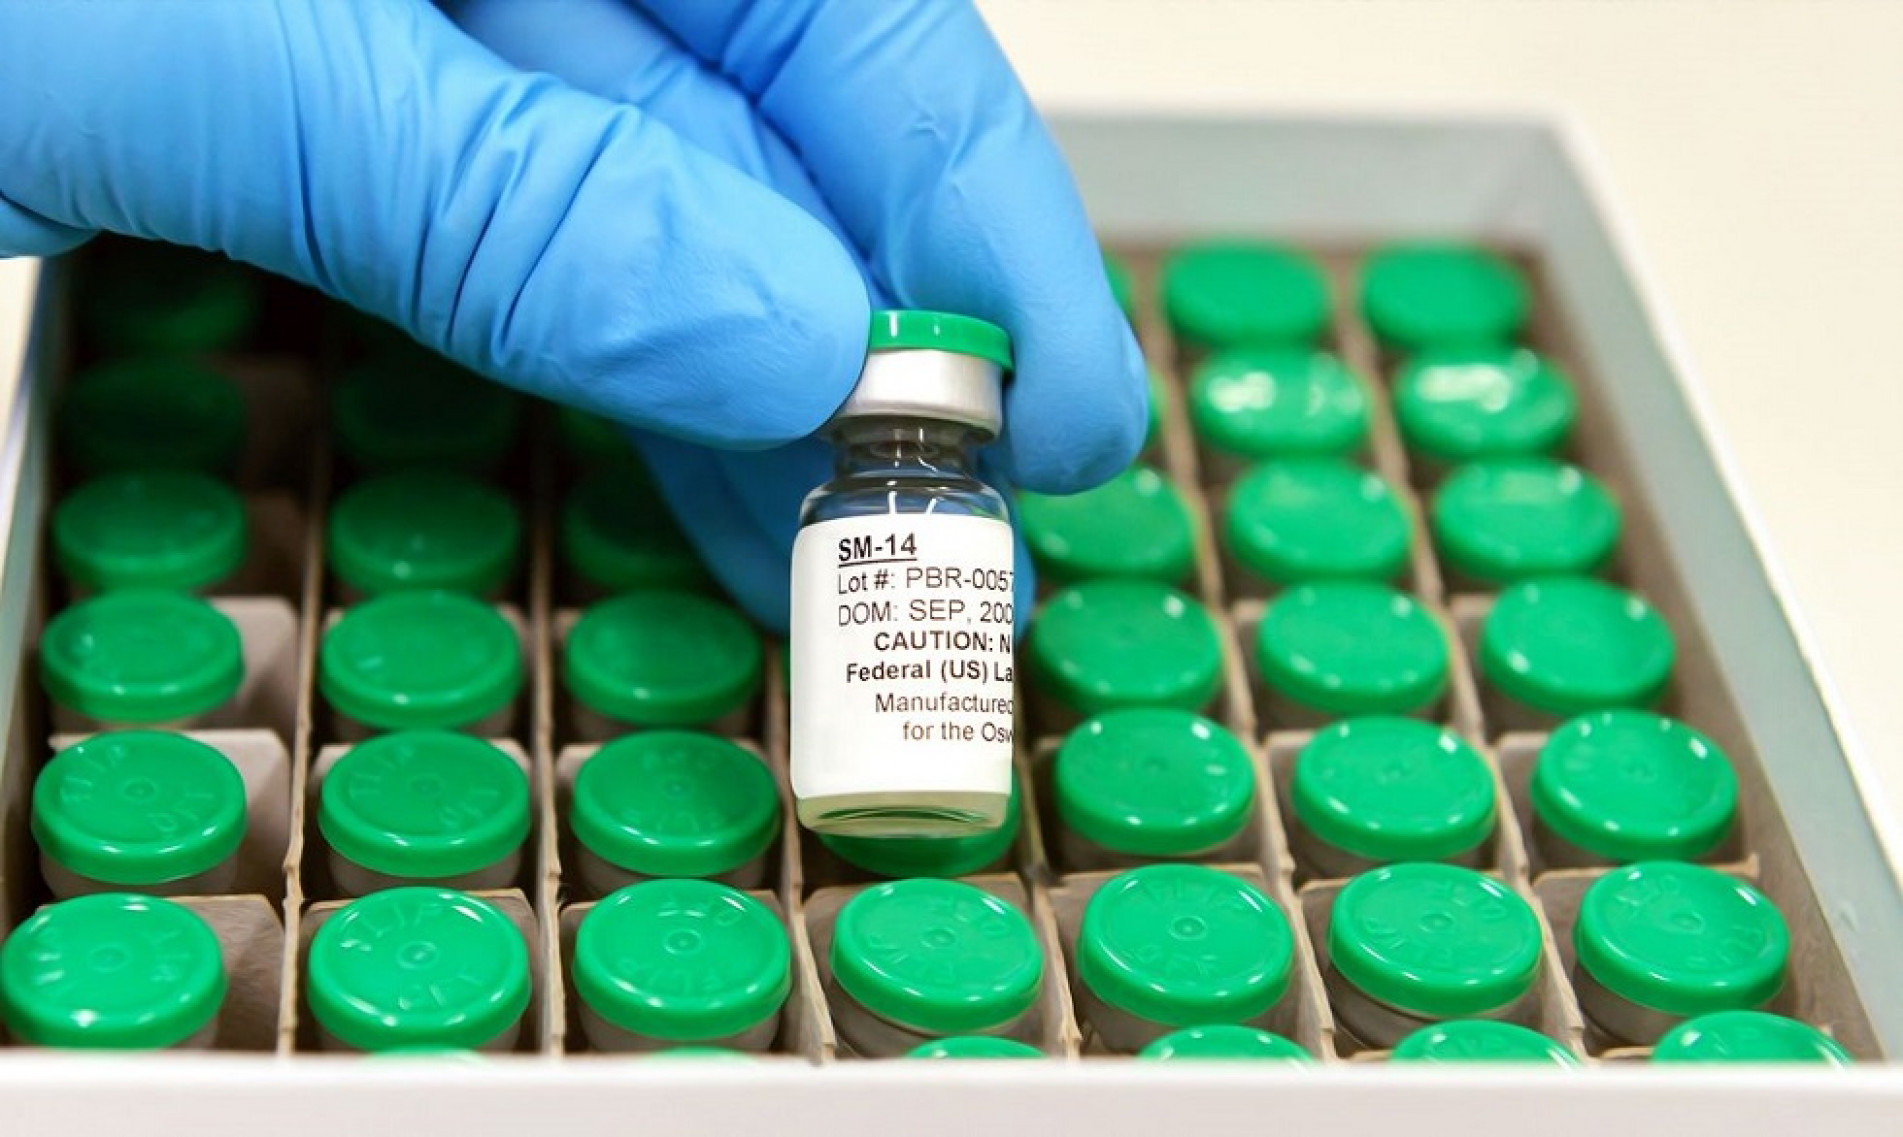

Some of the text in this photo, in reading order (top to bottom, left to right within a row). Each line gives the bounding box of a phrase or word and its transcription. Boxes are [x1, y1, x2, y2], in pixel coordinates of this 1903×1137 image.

[838, 533, 917, 565] SM-14
[838, 570, 868, 595] Lot
[874, 569, 896, 590] #:
[838, 601, 898, 627] DOM:
[909, 599, 972, 624] SEP,
[873, 631, 993, 652] CAUTION:
[846, 660, 931, 683] Federal
[941, 659, 988, 684] (US)
[902, 722, 934, 741] for
[941, 721, 975, 741] the
